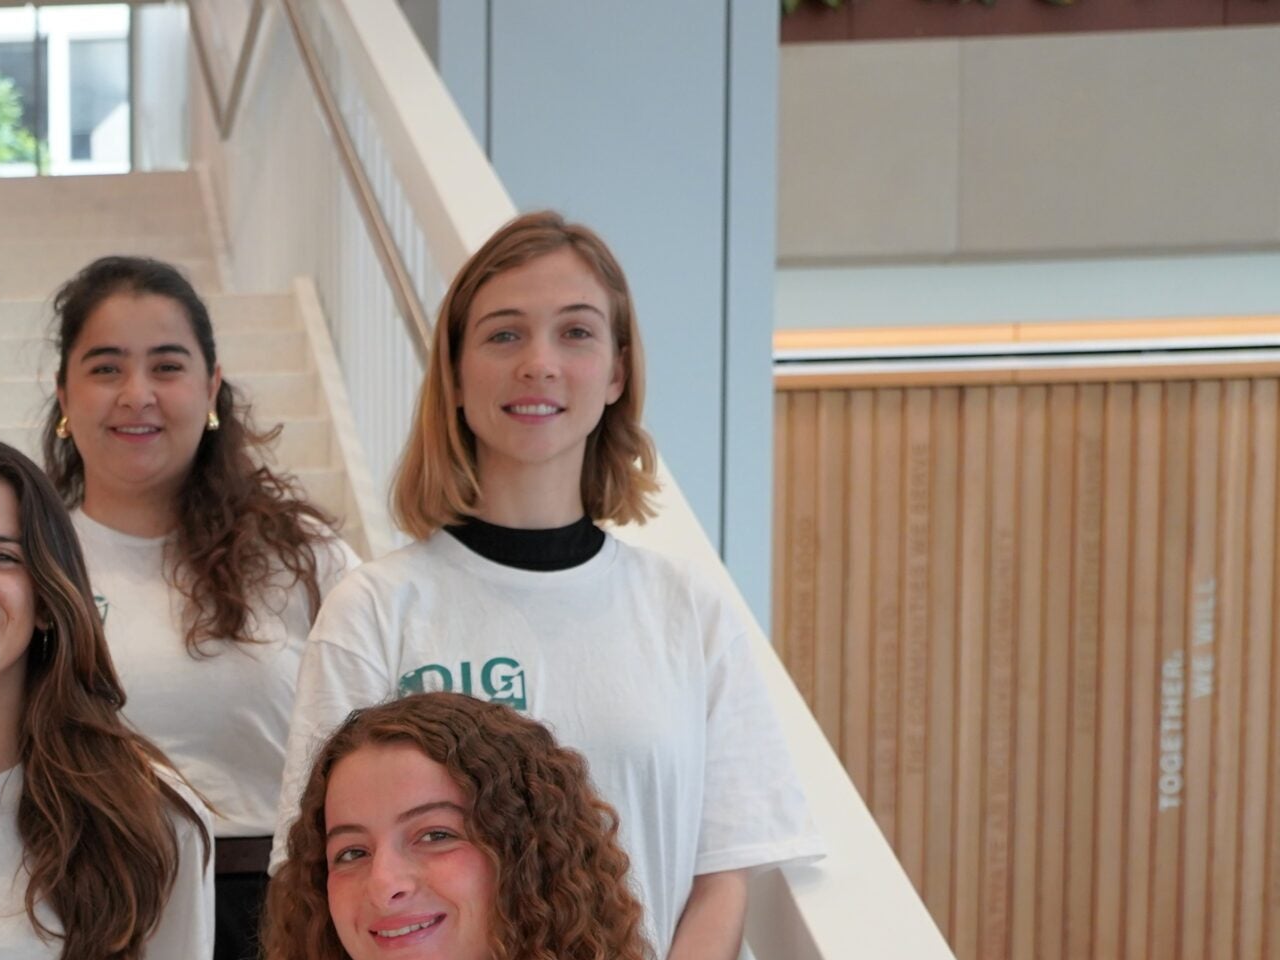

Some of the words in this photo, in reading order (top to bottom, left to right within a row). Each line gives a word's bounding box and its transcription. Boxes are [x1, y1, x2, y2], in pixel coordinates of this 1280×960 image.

[1191, 577, 1216, 646] WILL
[399, 657, 526, 708] DIG
[1190, 653, 1215, 700] WE
